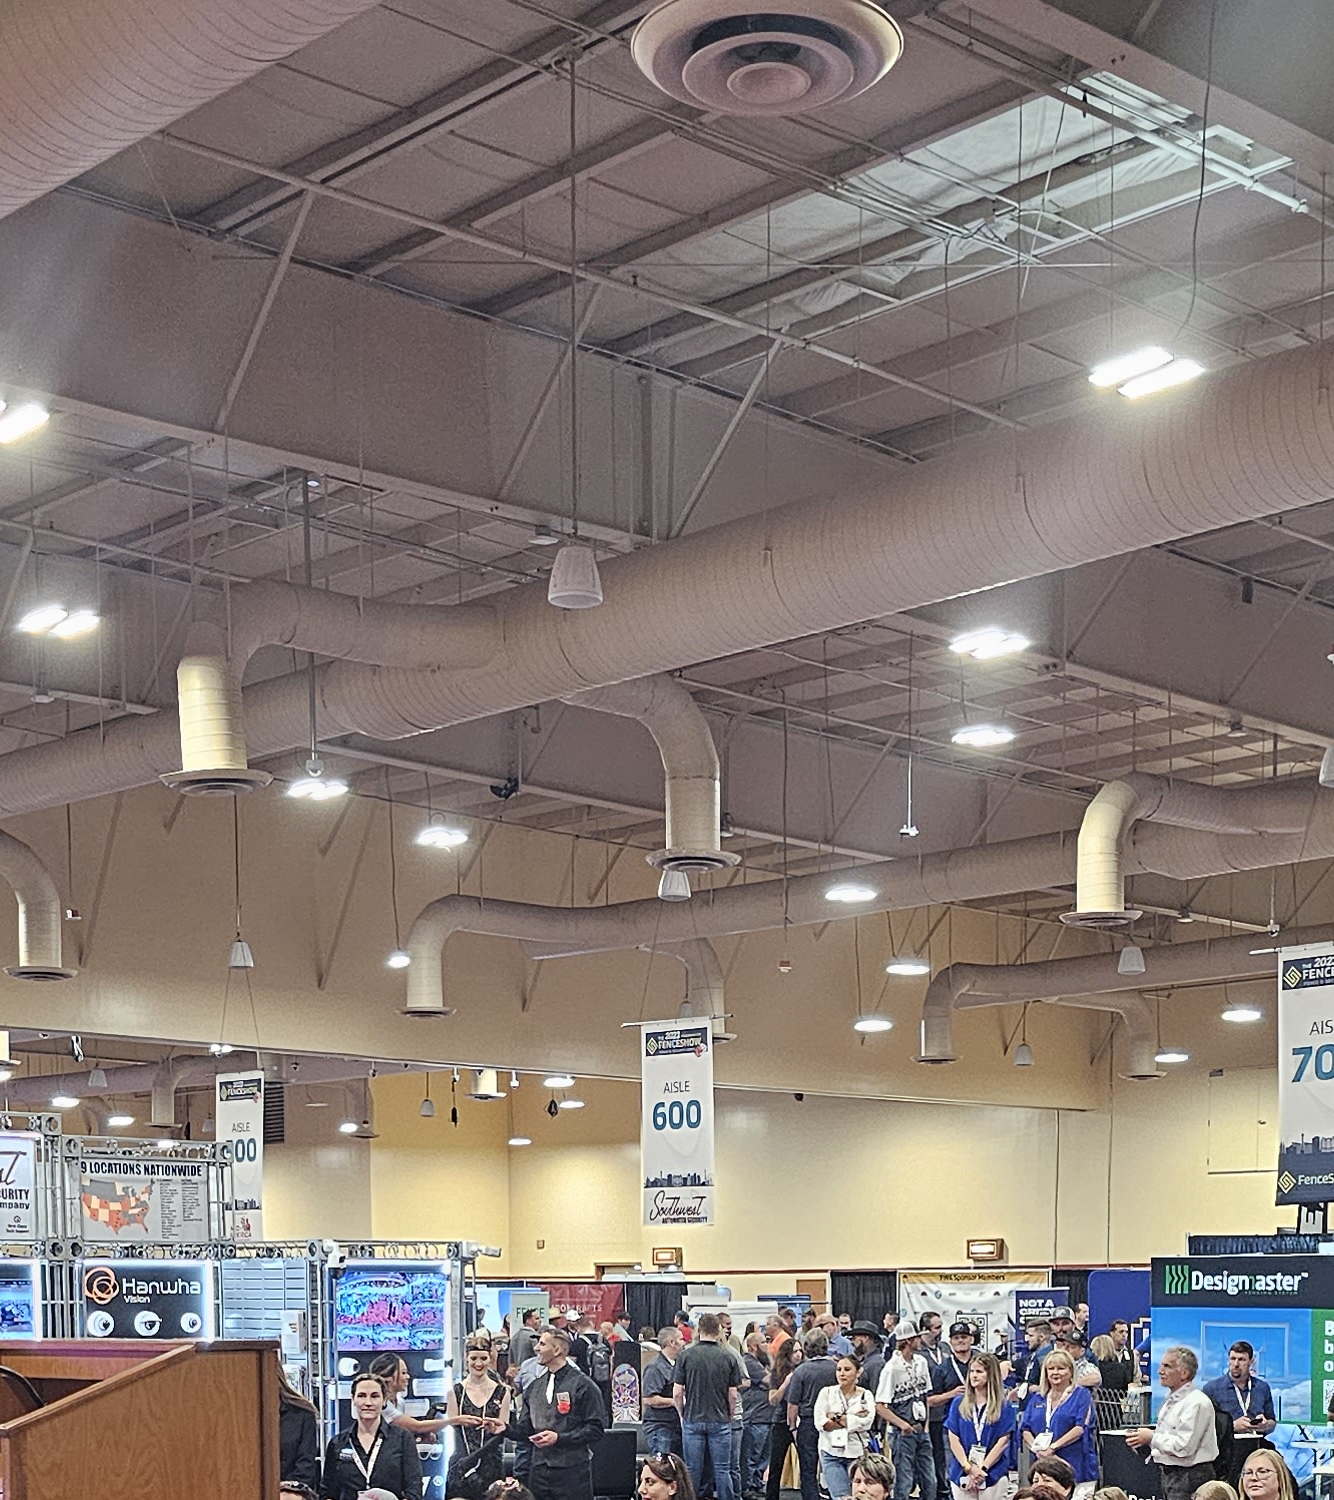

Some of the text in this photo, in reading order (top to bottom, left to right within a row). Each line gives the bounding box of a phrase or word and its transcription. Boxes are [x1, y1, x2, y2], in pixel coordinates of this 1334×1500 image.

[663, 1081, 690, 1093] AISLE
[652, 1100, 701, 1130] 600
[232, 1122, 250, 1132] AISLE
[90, 1162, 202, 1176] LOCATIONS NATIONWIDE
[650, 1190, 707, 1221] Southwest
[122, 1278, 201, 1295] Hanwha
[123, 1295, 150, 1304] Vision
[1019, 1299, 1054, 1308] NOT A
